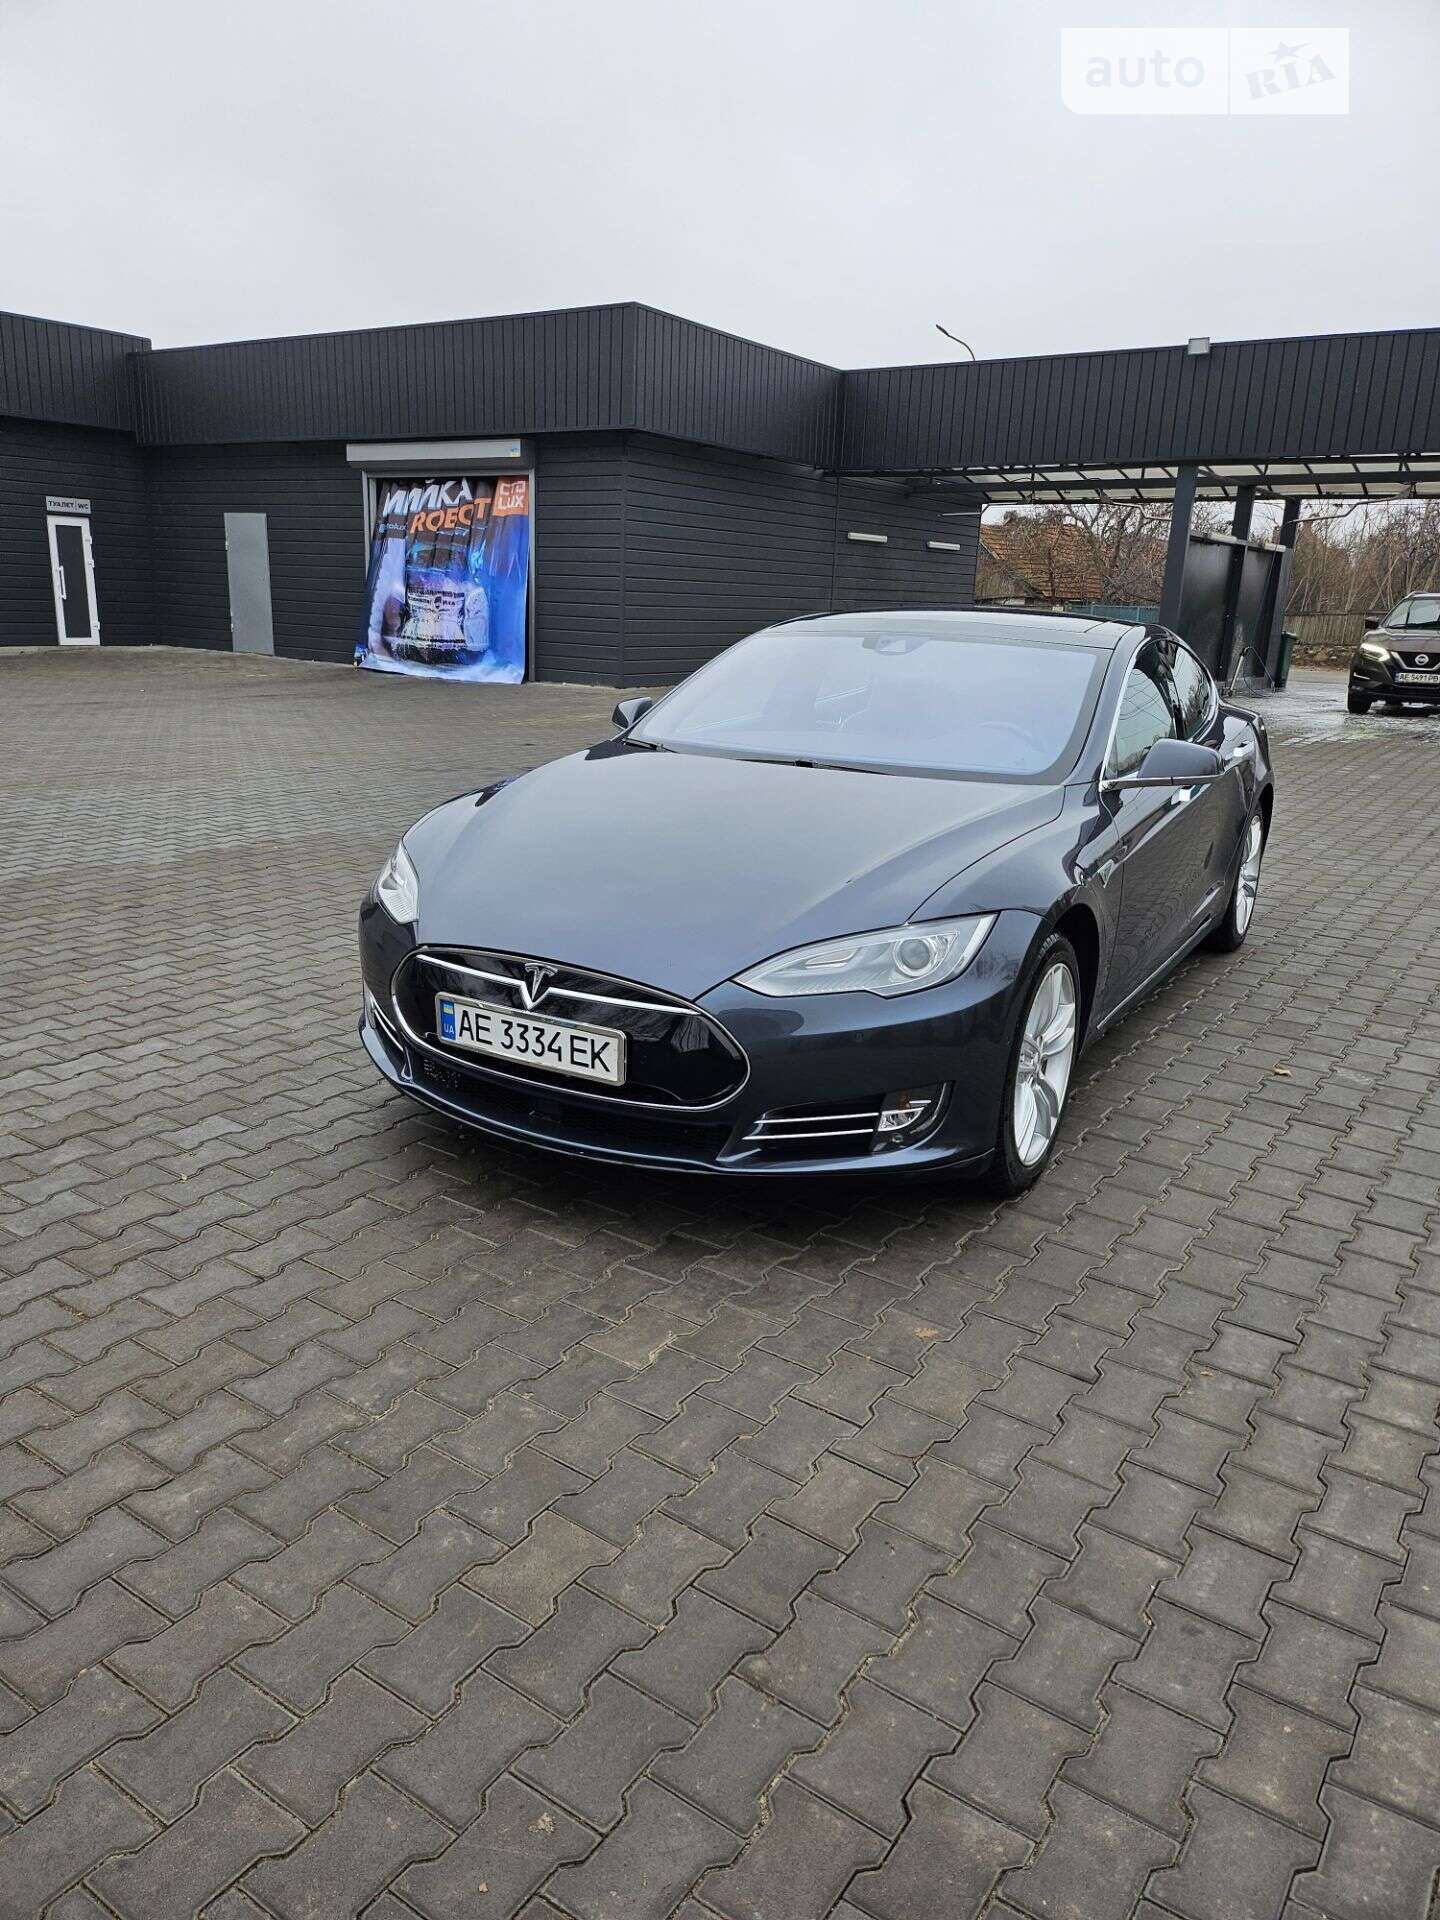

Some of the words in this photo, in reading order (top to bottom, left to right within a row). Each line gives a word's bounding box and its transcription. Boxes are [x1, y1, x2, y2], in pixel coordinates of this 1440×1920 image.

[498, 495, 525, 510] LUX
[443, 1024, 455, 1035] UA
[458, 1009, 493, 1046] AE
[500, 1019, 563, 1062] 3334
[569, 1034, 611, 1072] EK
